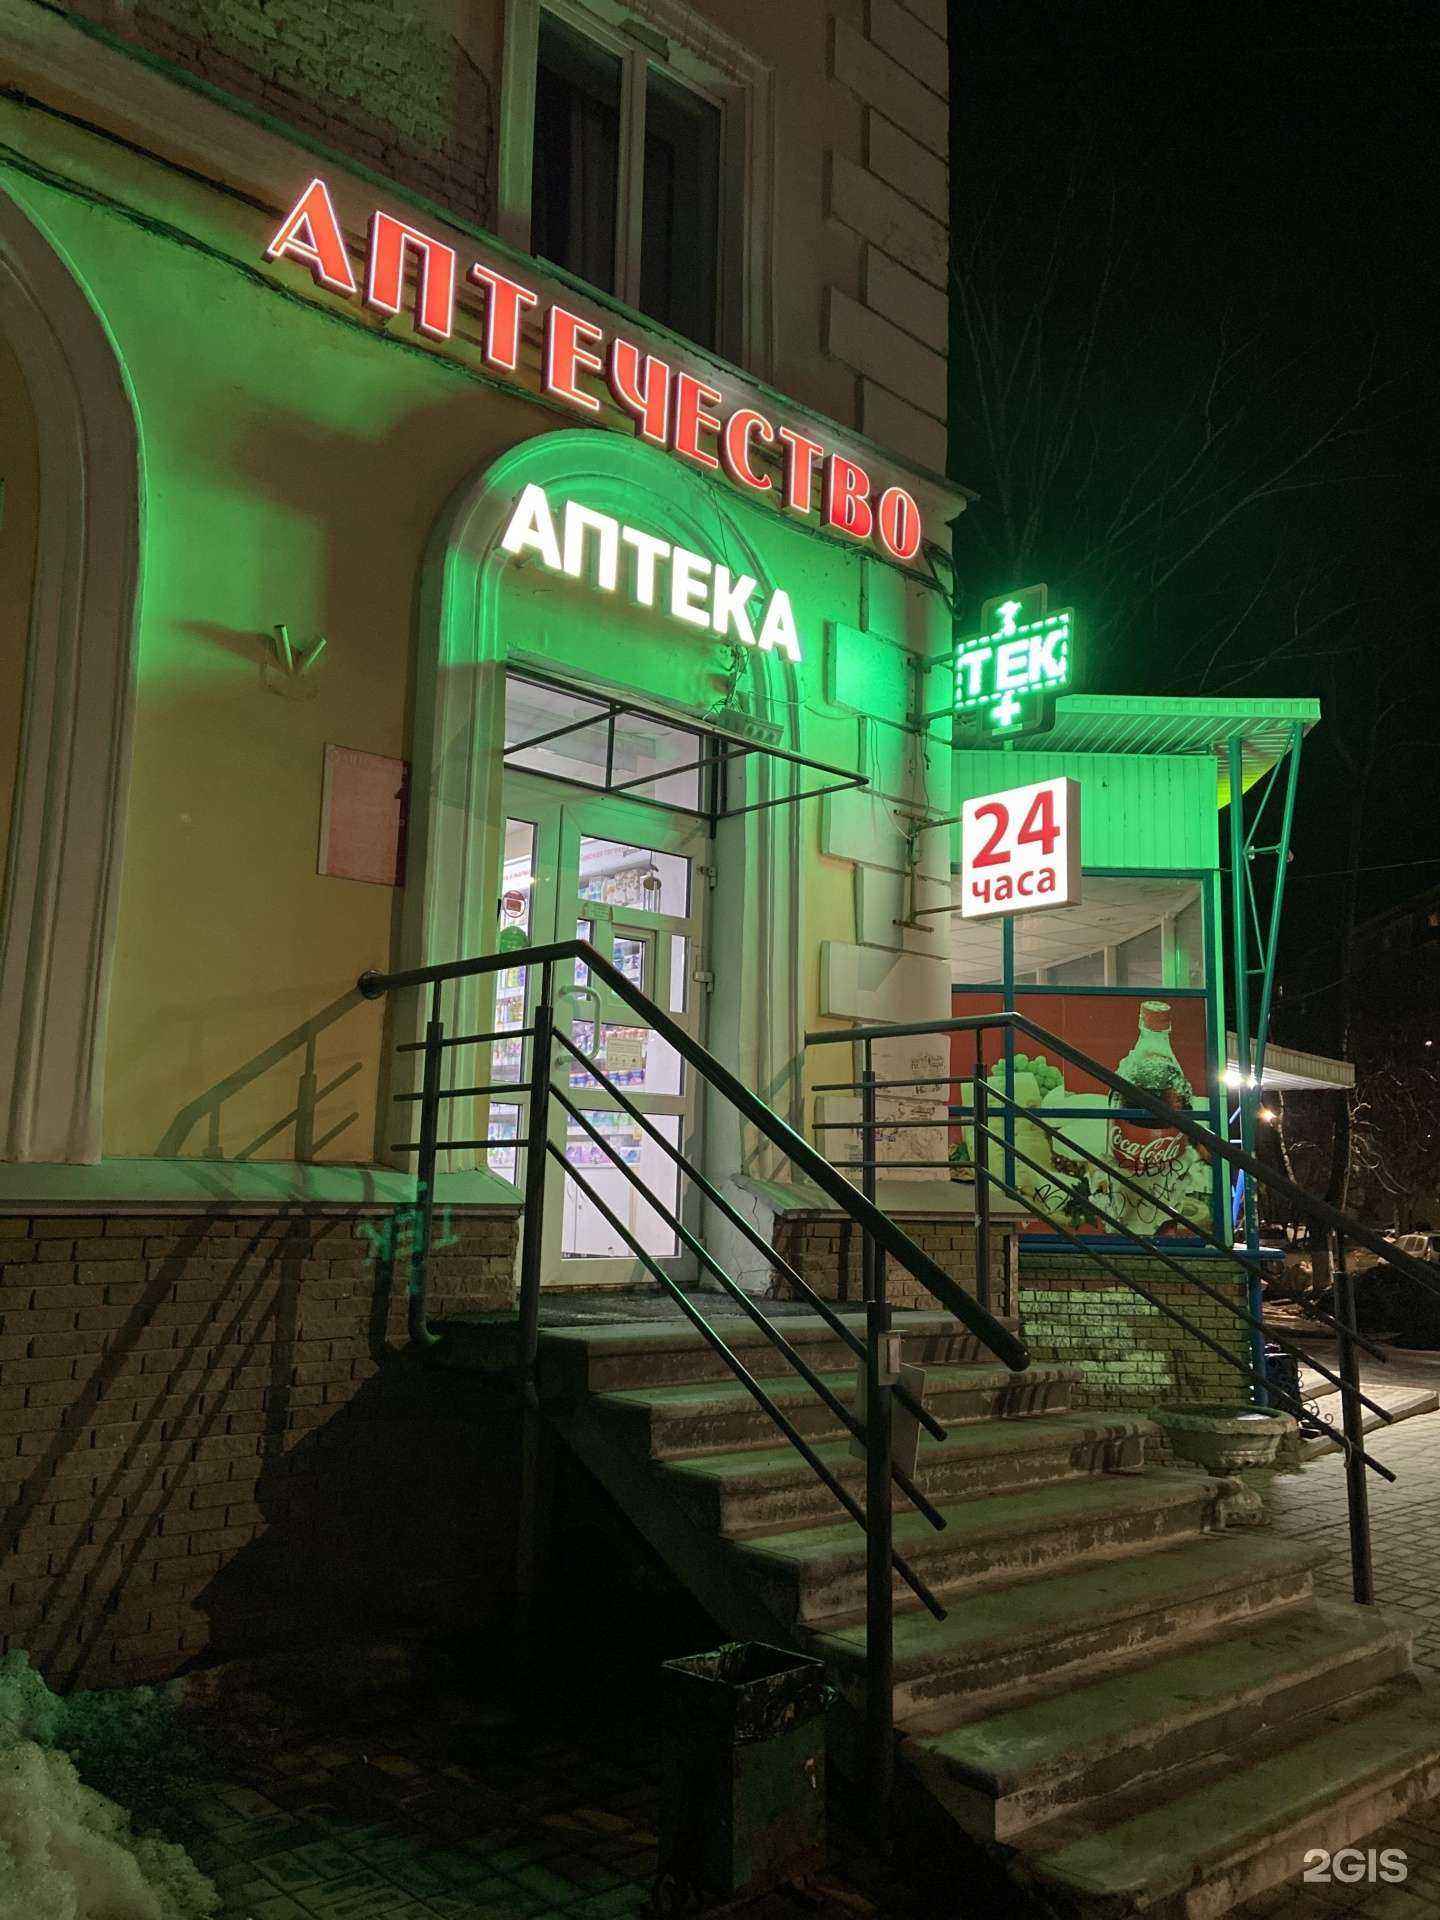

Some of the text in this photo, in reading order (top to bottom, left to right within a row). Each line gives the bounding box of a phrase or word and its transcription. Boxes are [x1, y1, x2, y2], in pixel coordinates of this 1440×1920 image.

[265, 178, 922, 560] АПТЕЧЕСТВО
[501, 482, 803, 664] АПТЕКА
[972, 789, 1061, 869] 24
[972, 867, 1056, 904] часа
